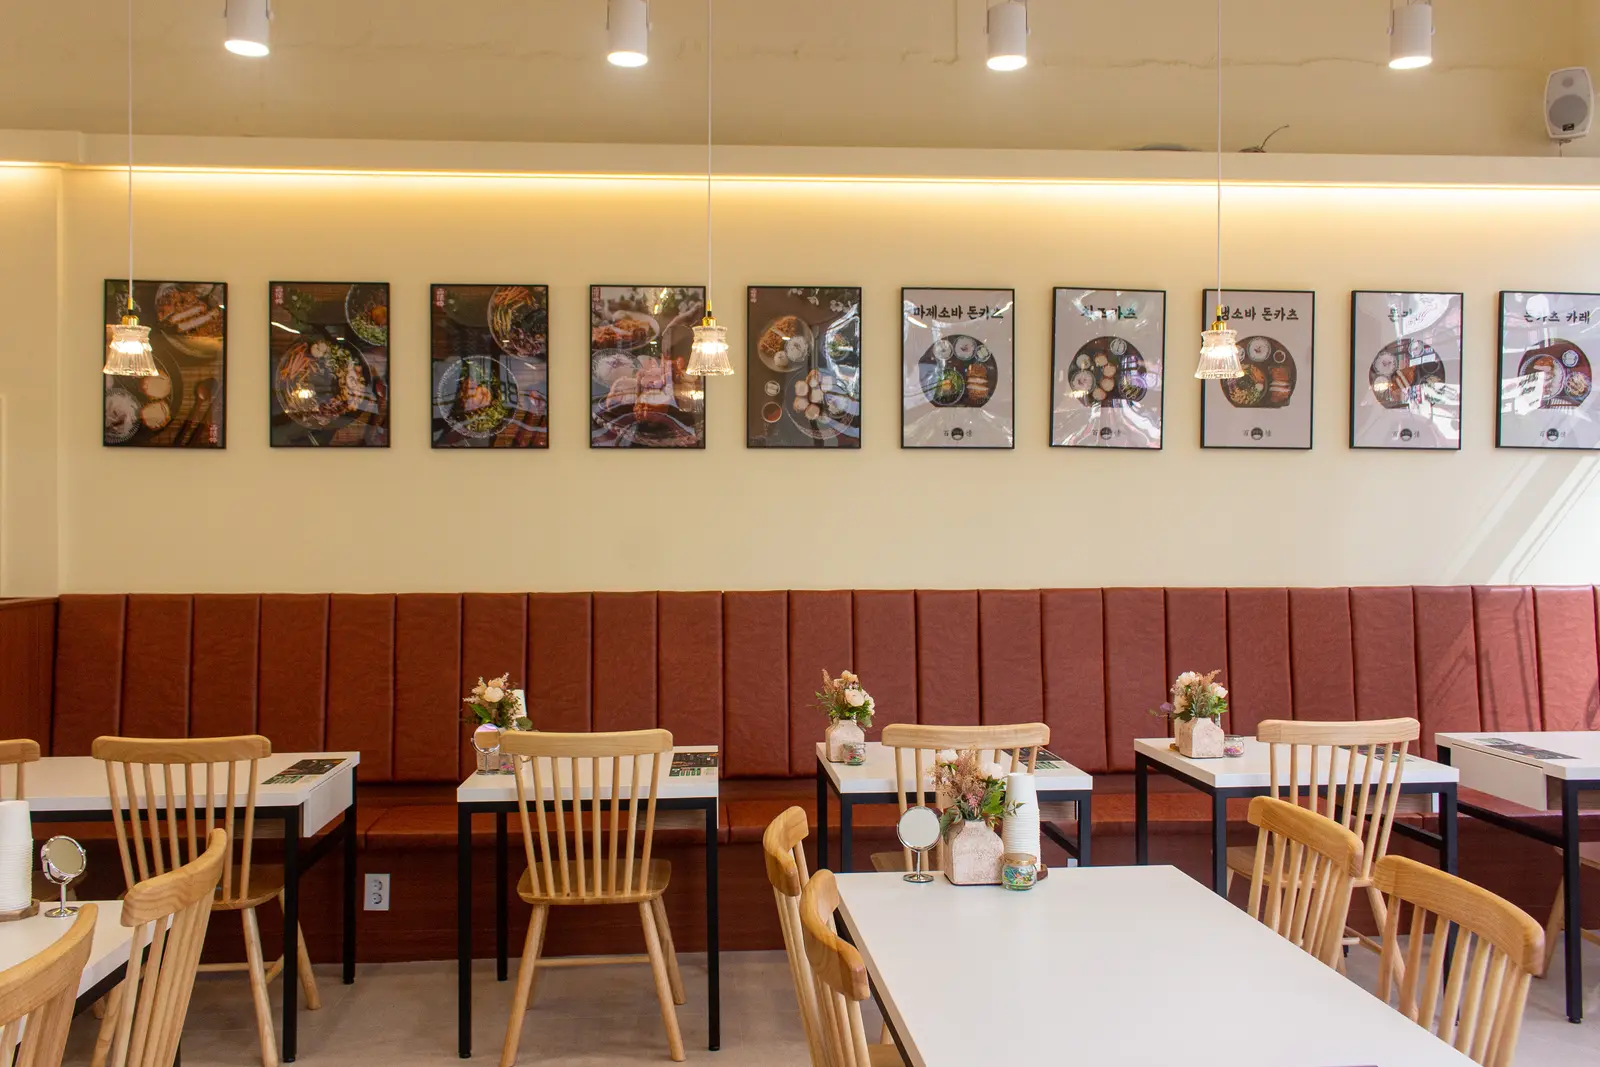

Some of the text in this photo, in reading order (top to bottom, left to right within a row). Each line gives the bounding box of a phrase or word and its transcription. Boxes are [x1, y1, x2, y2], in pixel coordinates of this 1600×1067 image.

[913, 304, 963, 320] 마제소바
[1221, 306, 1299, 321] 냉소바 돈카츠
[1566, 309, 1591, 324] 카레
